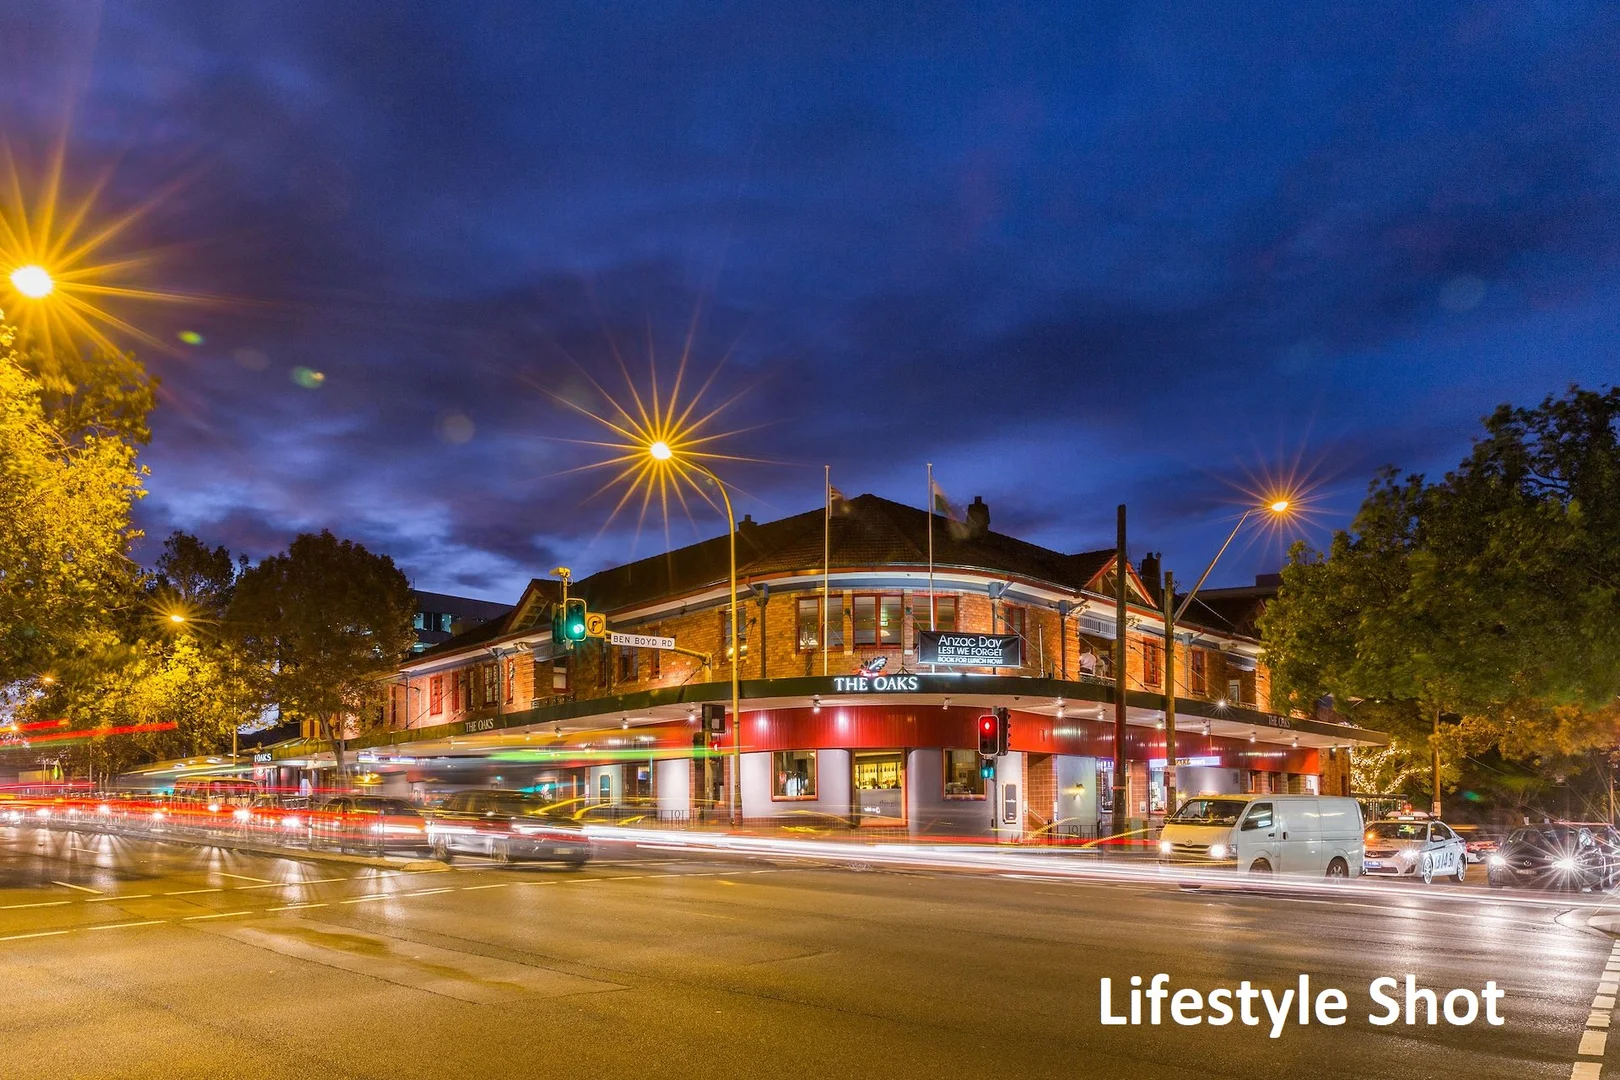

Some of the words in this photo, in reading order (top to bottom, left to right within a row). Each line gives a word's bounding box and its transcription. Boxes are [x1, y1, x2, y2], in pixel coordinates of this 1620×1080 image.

[613, 635, 631, 644] BEN
[634, 637, 658, 646] BOYD
[938, 634, 976, 647] Anzac
[978, 636, 1003, 649] Day
[938, 647, 955, 655] LEST
[956, 647, 970, 655] WE
[971, 648, 1003, 657] FORGET
[833, 677, 868, 691] THE
[873, 677, 918, 691] OAKS
[465, 720, 477, 733] THE
[478, 718, 494, 731] OAKS
